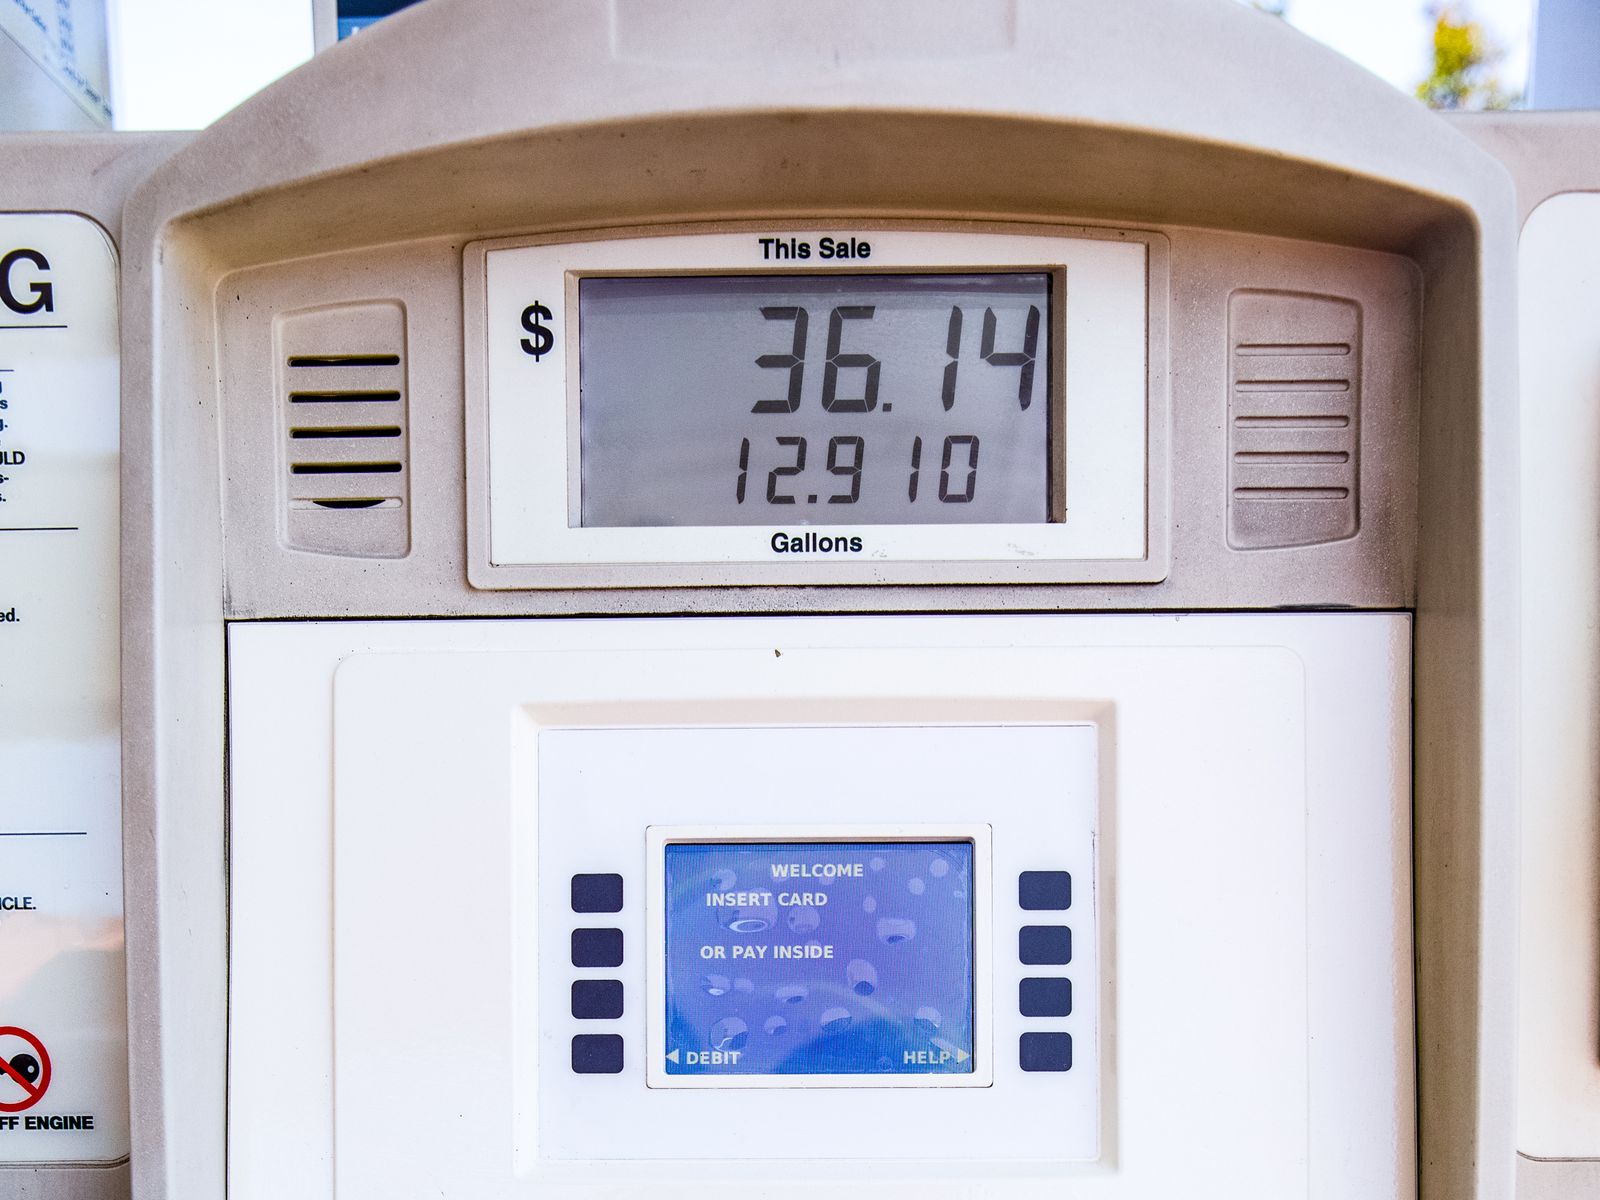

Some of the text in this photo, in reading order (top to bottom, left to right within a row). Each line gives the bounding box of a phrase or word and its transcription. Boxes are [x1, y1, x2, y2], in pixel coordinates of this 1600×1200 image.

[759, 238, 871, 260] This Sale
[0, 248, 54, 315] G
[520, 300, 554, 362] $
[751, 305, 1041, 413] 36.14
[736, 434, 980, 504] 12.910
[770, 532, 863, 555] Gallons
[771, 863, 864, 878] WELCOME
[706, 892, 828, 907] INSERT CARD
[700, 945, 834, 960] OR PAY INSIDE
[686, 1051, 741, 1065] DEBIT
[903, 1050, 951, 1065] HELP
[25, 1115, 94, 1130] ENGINE
